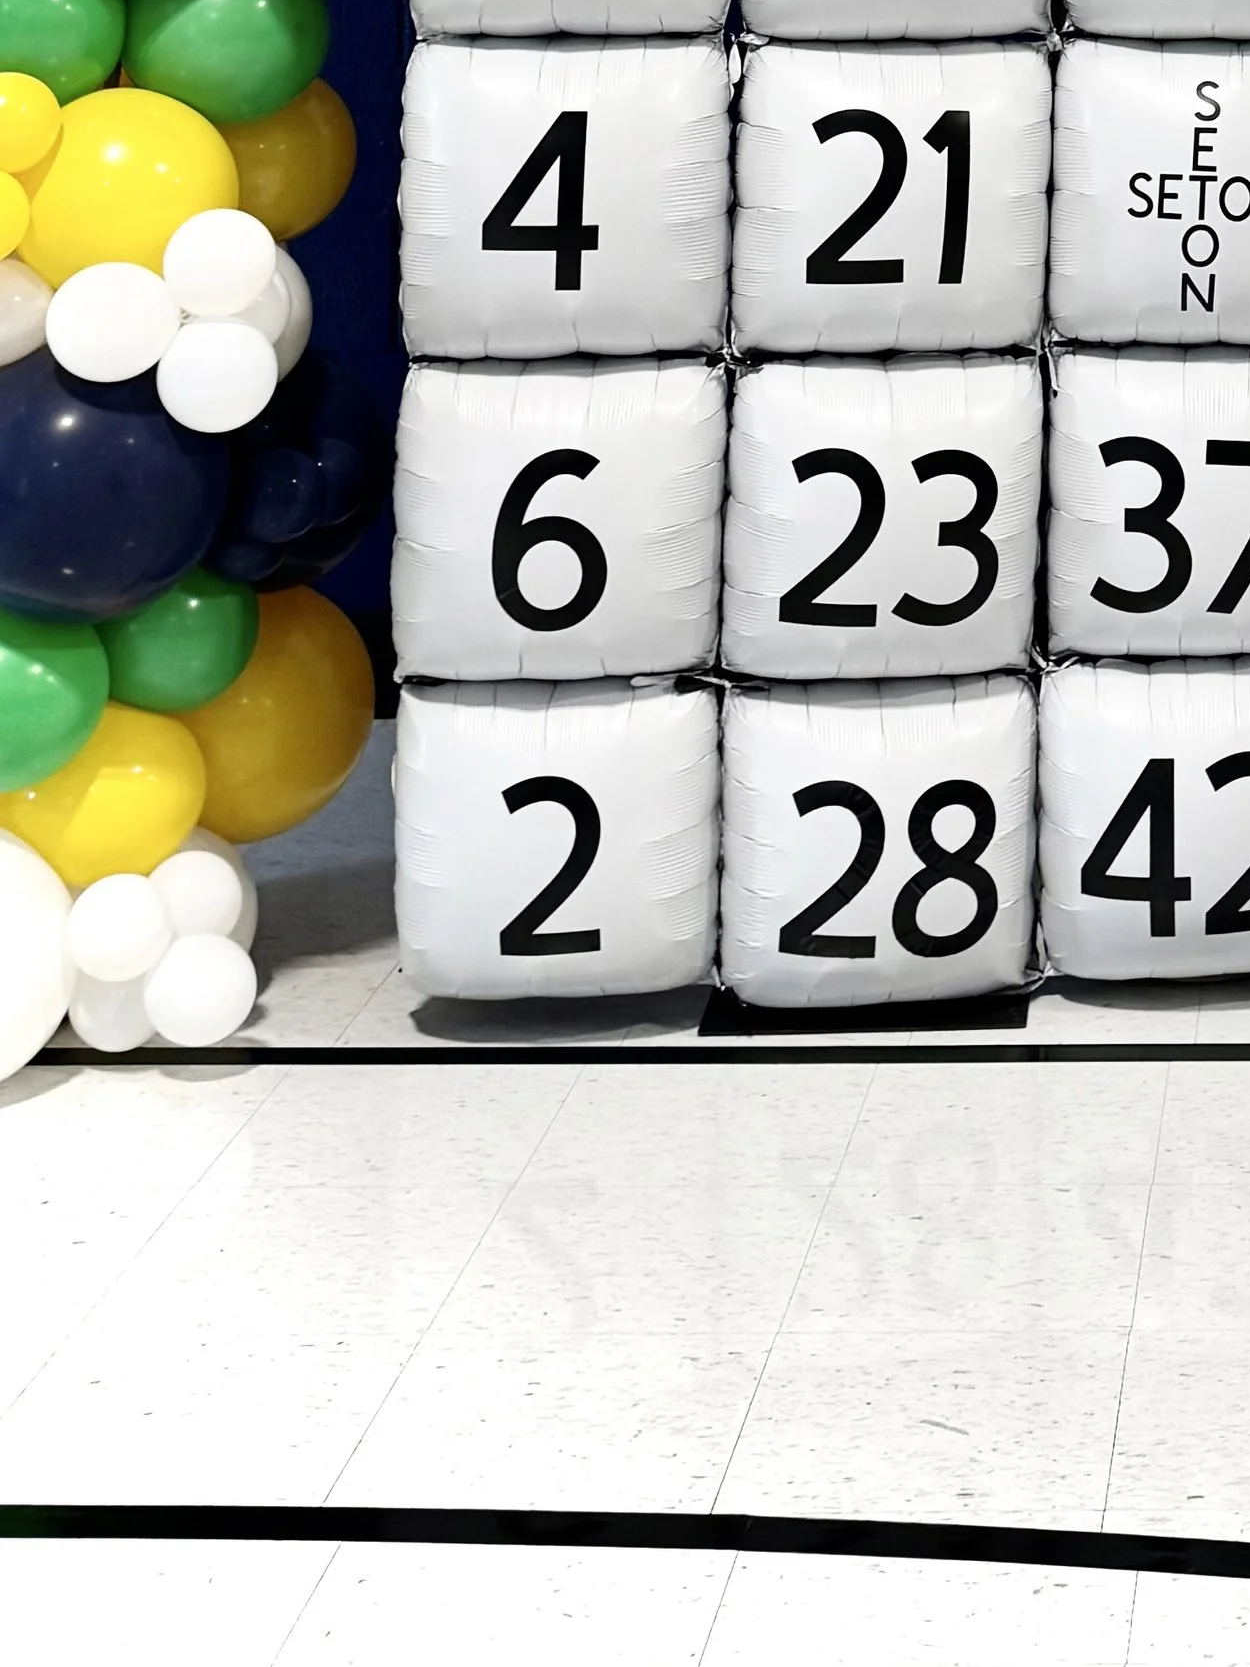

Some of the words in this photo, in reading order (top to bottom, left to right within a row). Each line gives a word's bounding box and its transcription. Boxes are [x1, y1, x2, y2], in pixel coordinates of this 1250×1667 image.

[482, 111, 599, 290] 4
[806, 109, 970, 284] 21
[1181, 80, 1221, 313] SETON
[492, 449, 607, 631] 6
[779, 448, 998, 627] 23
[500, 776, 600, 956] 2
[779, 780, 998, 959] 28
